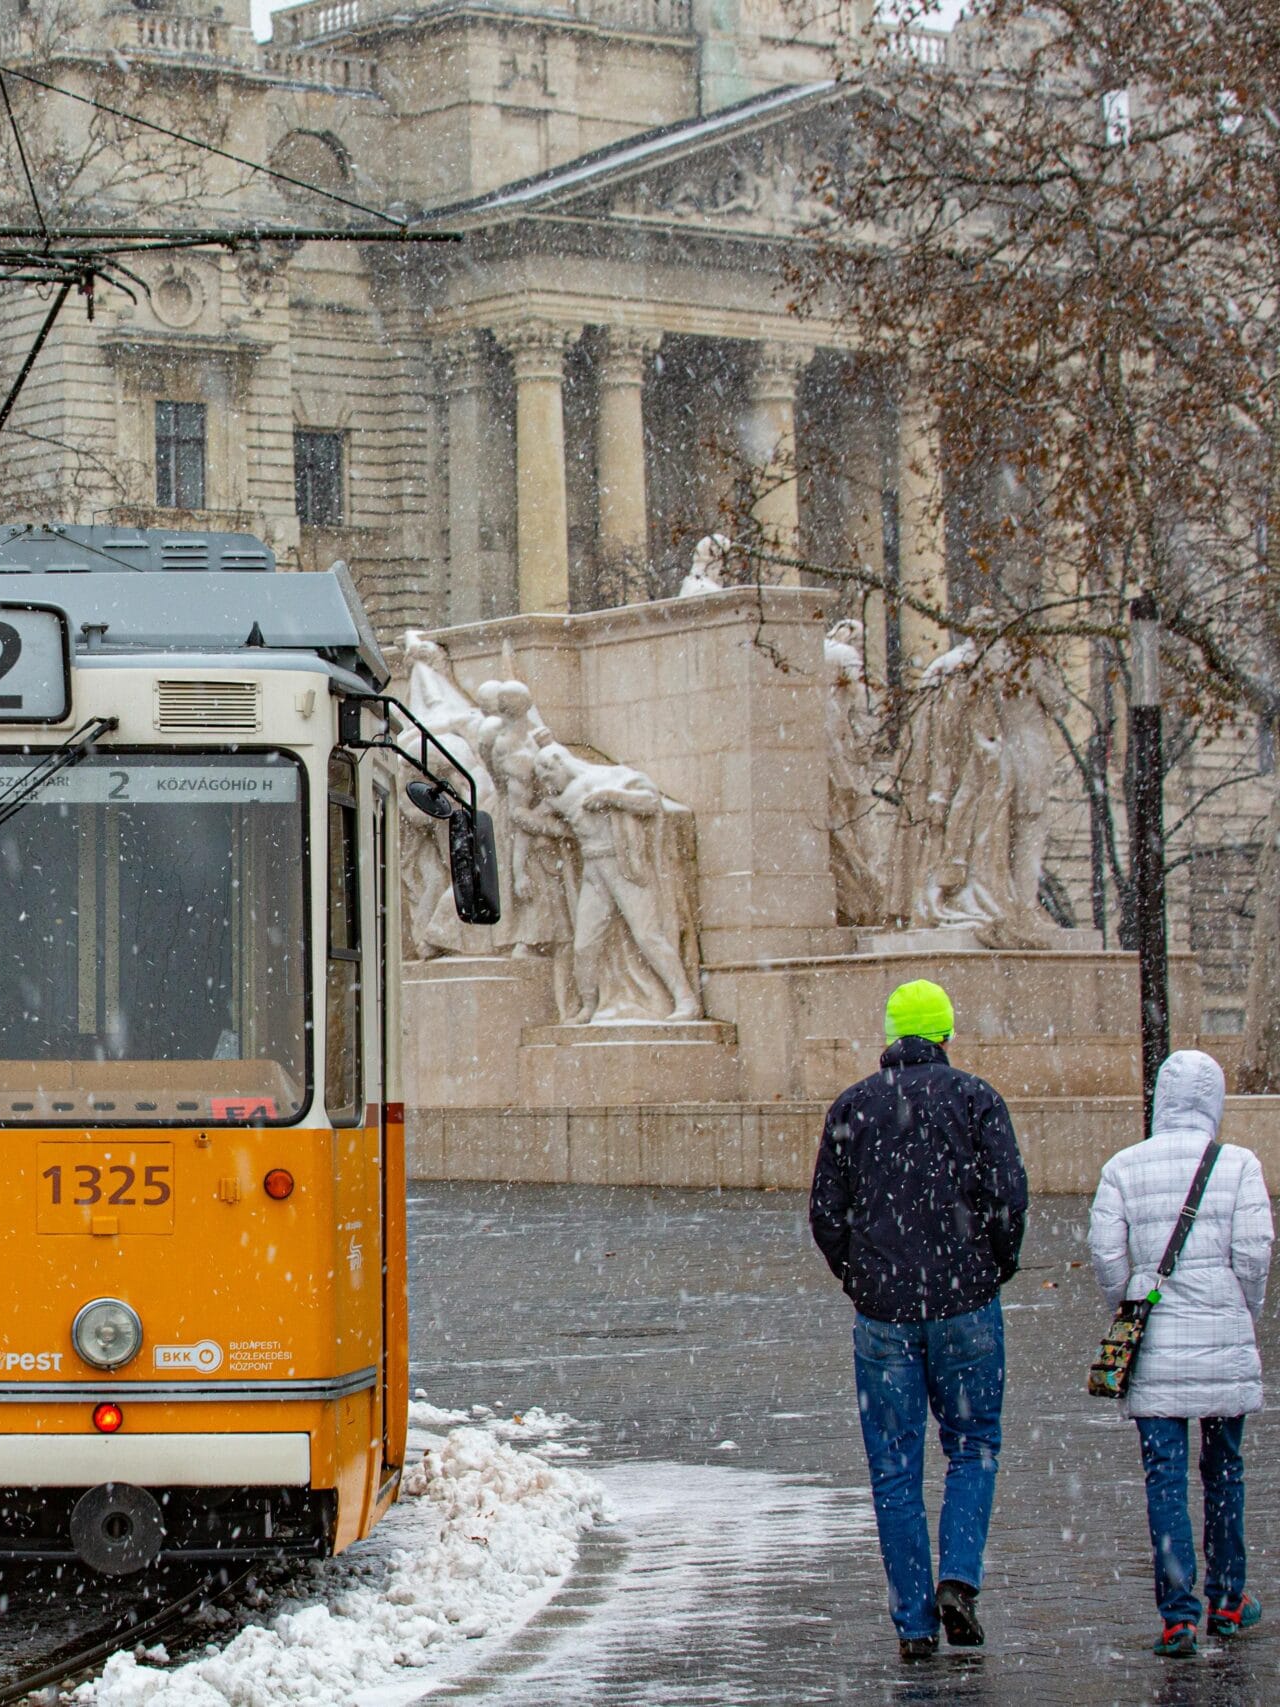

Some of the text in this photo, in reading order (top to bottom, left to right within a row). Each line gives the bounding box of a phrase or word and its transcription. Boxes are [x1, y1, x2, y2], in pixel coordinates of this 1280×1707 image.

[108, 771, 130, 799] 2
[263, 780, 273, 791] H
[42, 1165, 171, 1205] 1325
[229, 1340, 281, 1350] BUDAPESTI
[162, 1352, 192, 1362] BKK
